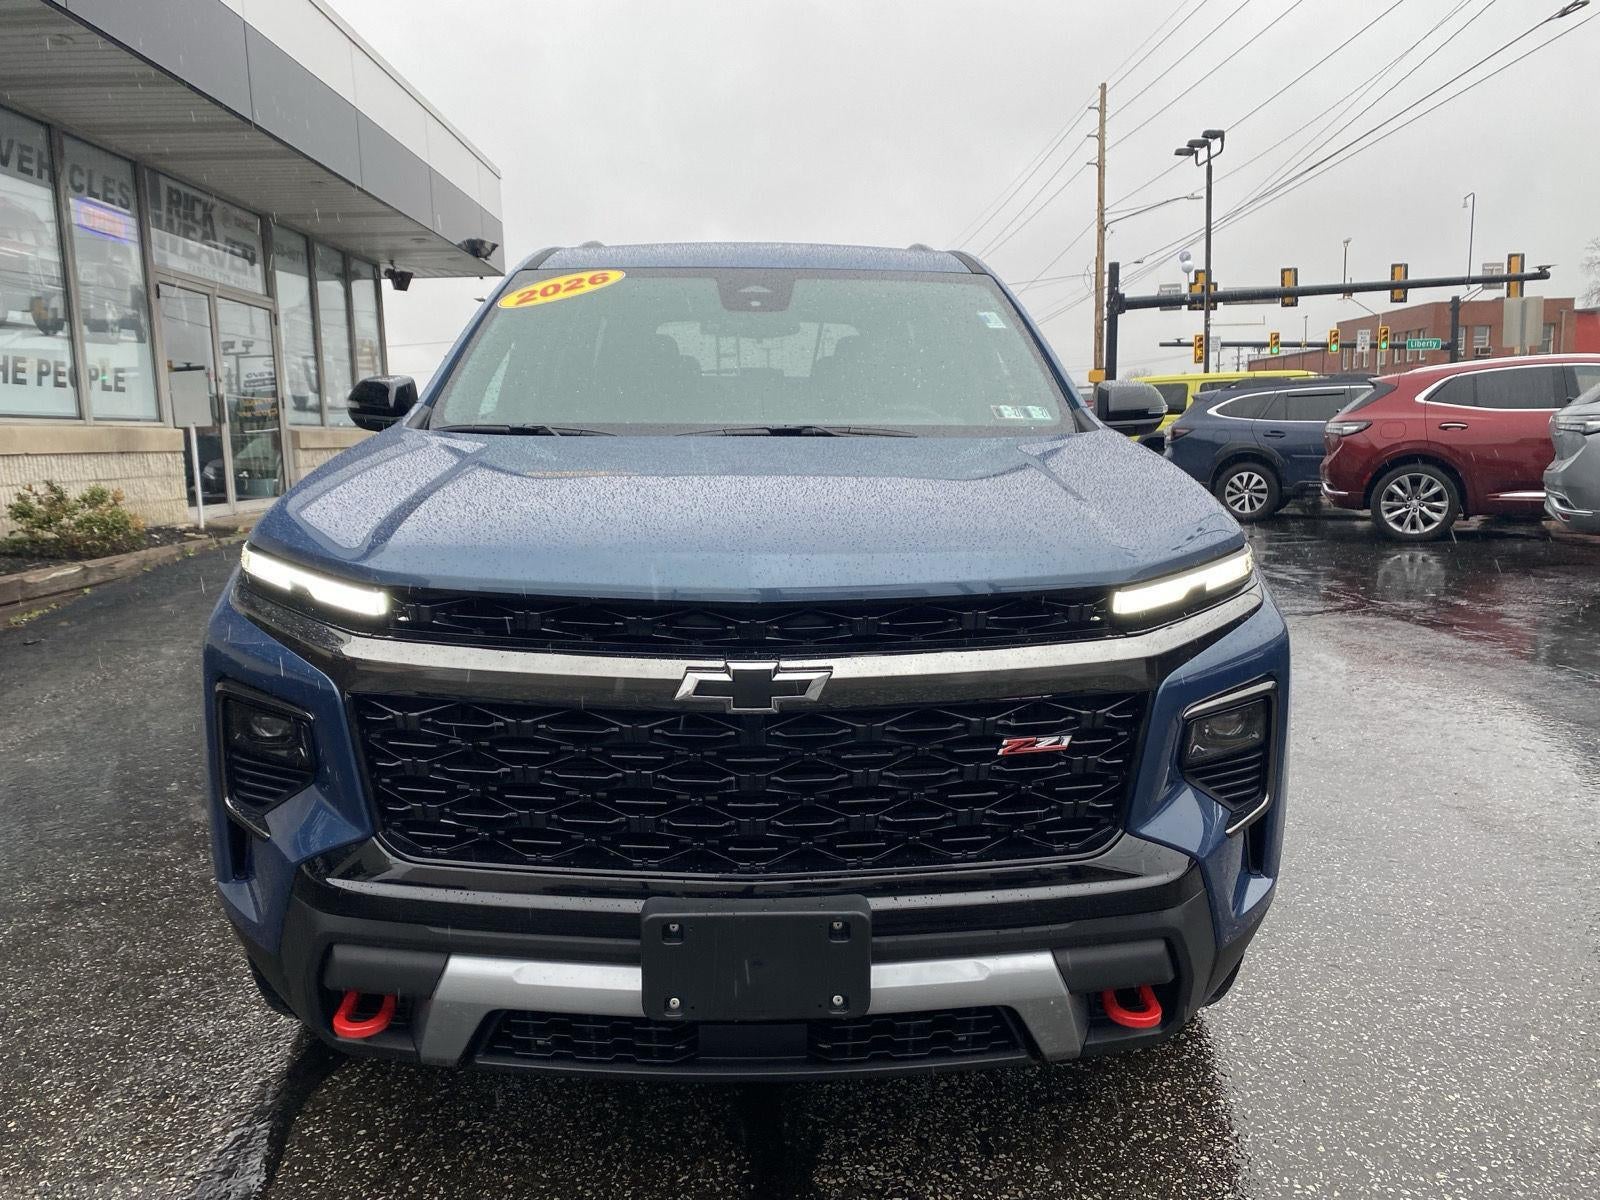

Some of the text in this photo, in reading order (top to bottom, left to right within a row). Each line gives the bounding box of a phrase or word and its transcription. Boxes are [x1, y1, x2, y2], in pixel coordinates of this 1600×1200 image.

[515, 272, 611, 306] 2026
[1410, 340, 1438, 349] Liberty
[998, 736, 1072, 755] Z71
